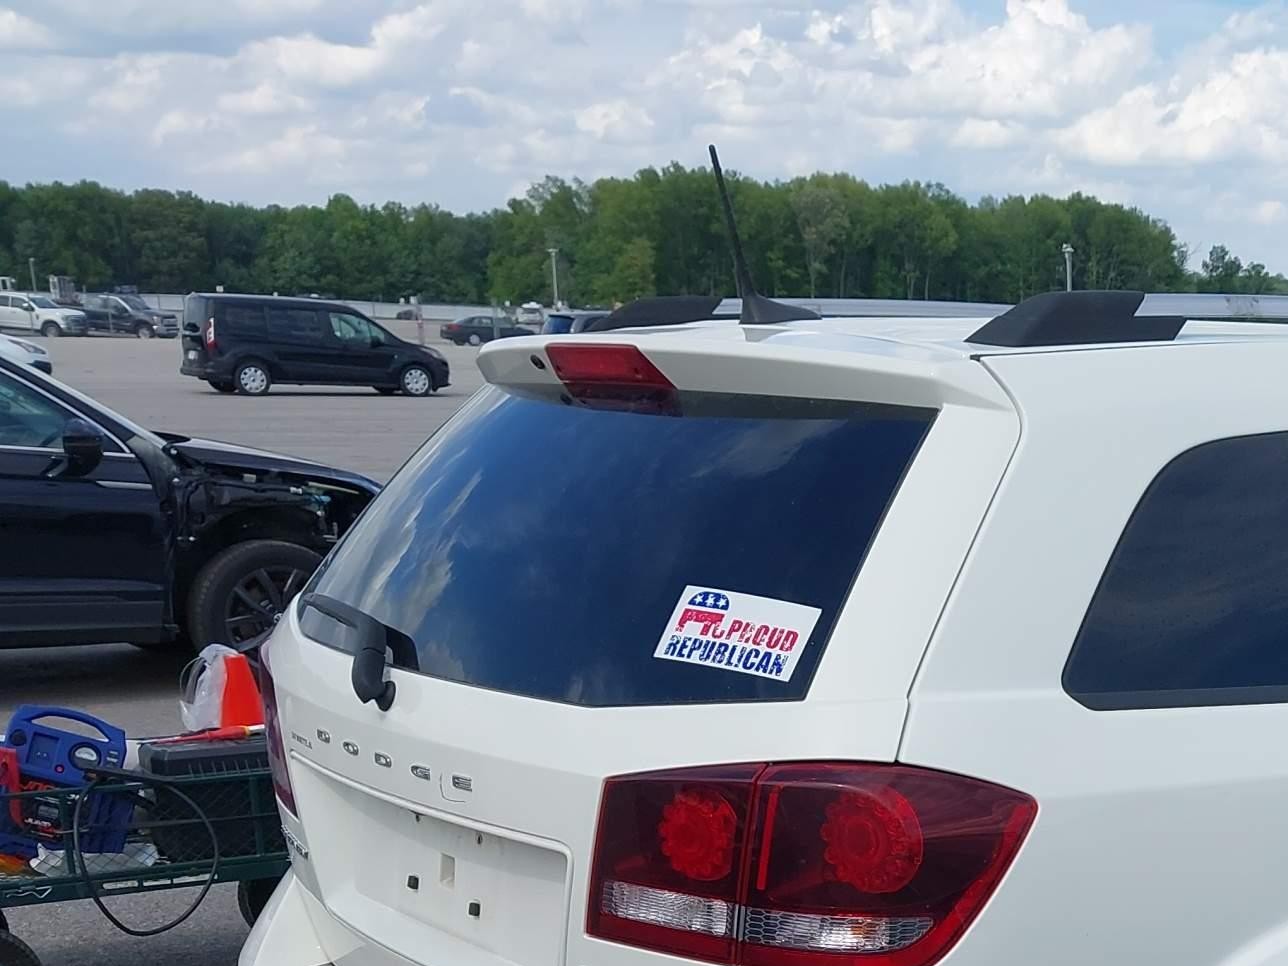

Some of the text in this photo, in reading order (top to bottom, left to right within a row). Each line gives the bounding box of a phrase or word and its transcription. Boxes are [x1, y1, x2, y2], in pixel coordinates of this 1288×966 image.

[664, 634, 789, 677] REPUBLICAN
[727, 619, 800, 652] PROUD
[316, 728, 473, 793] DODGE
